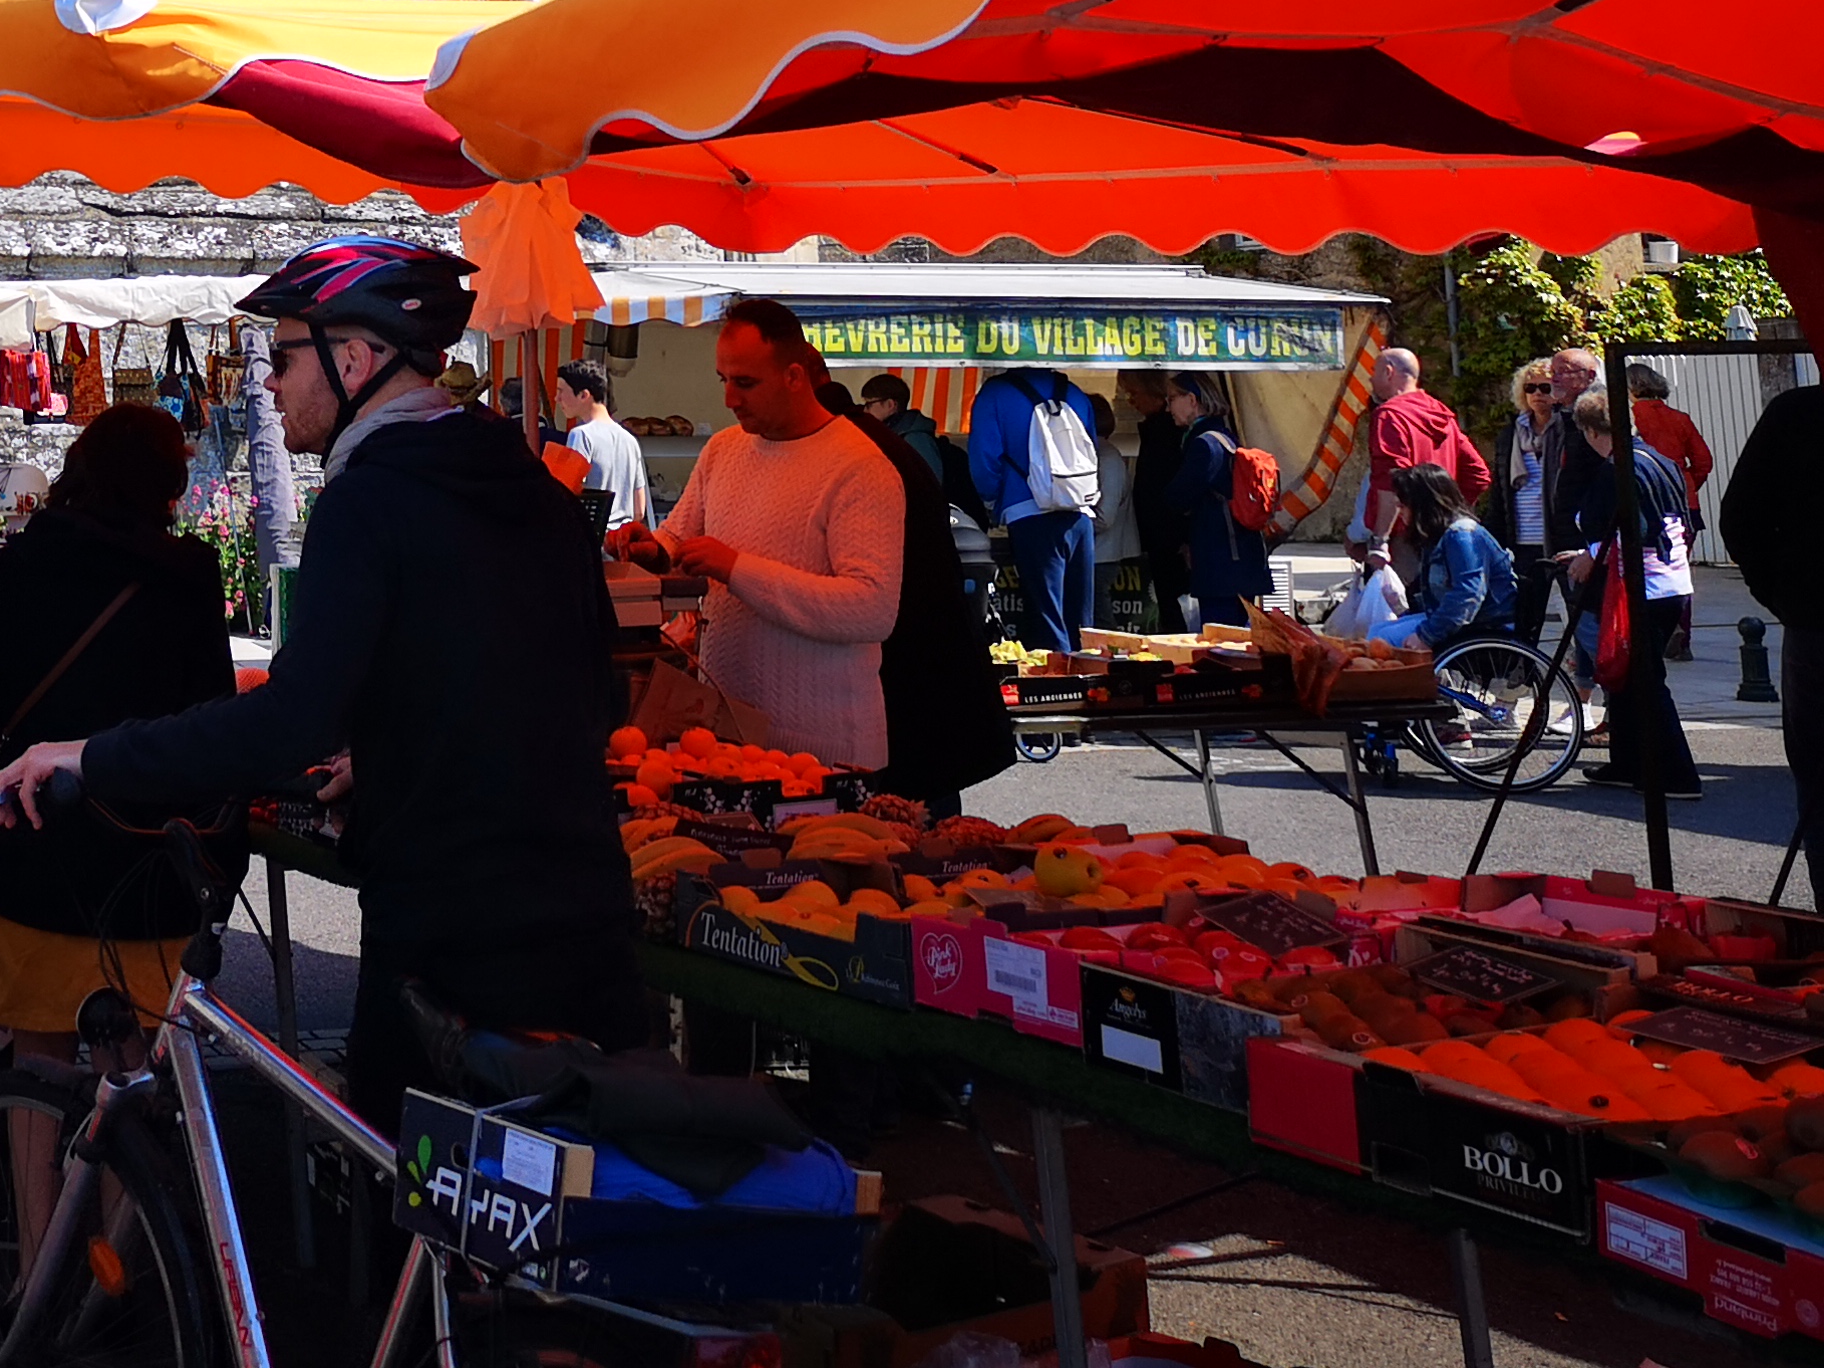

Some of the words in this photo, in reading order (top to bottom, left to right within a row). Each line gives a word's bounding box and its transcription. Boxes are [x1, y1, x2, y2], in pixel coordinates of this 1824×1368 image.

[976, 316, 1020, 355] DU
[1031, 316, 1166, 356] VILLAGE
[1175, 317, 1218, 356] DE
[1462, 1143, 1564, 1195] BOLLO
